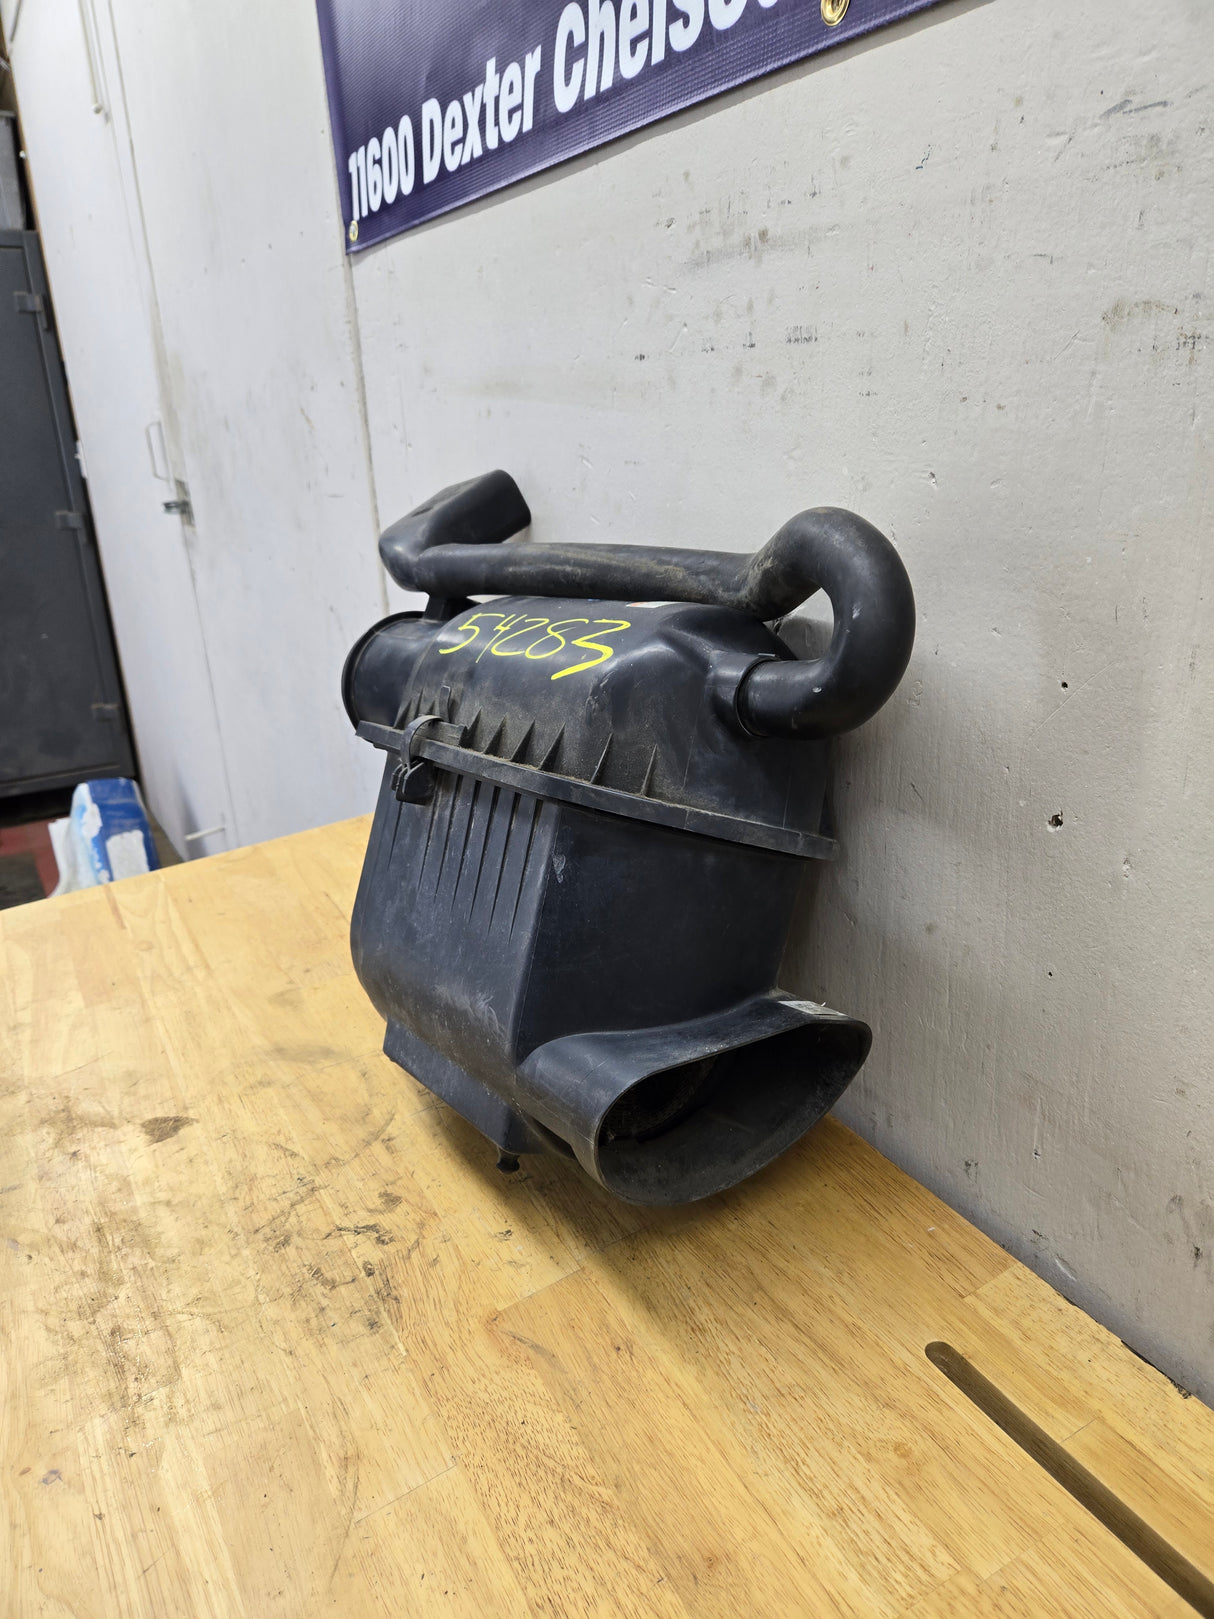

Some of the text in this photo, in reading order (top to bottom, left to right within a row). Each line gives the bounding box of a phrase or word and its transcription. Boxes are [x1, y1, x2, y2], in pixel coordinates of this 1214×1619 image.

[348, 0, 778, 221] 11600 Dexter Chels
[438, 612, 632, 681] 54283
